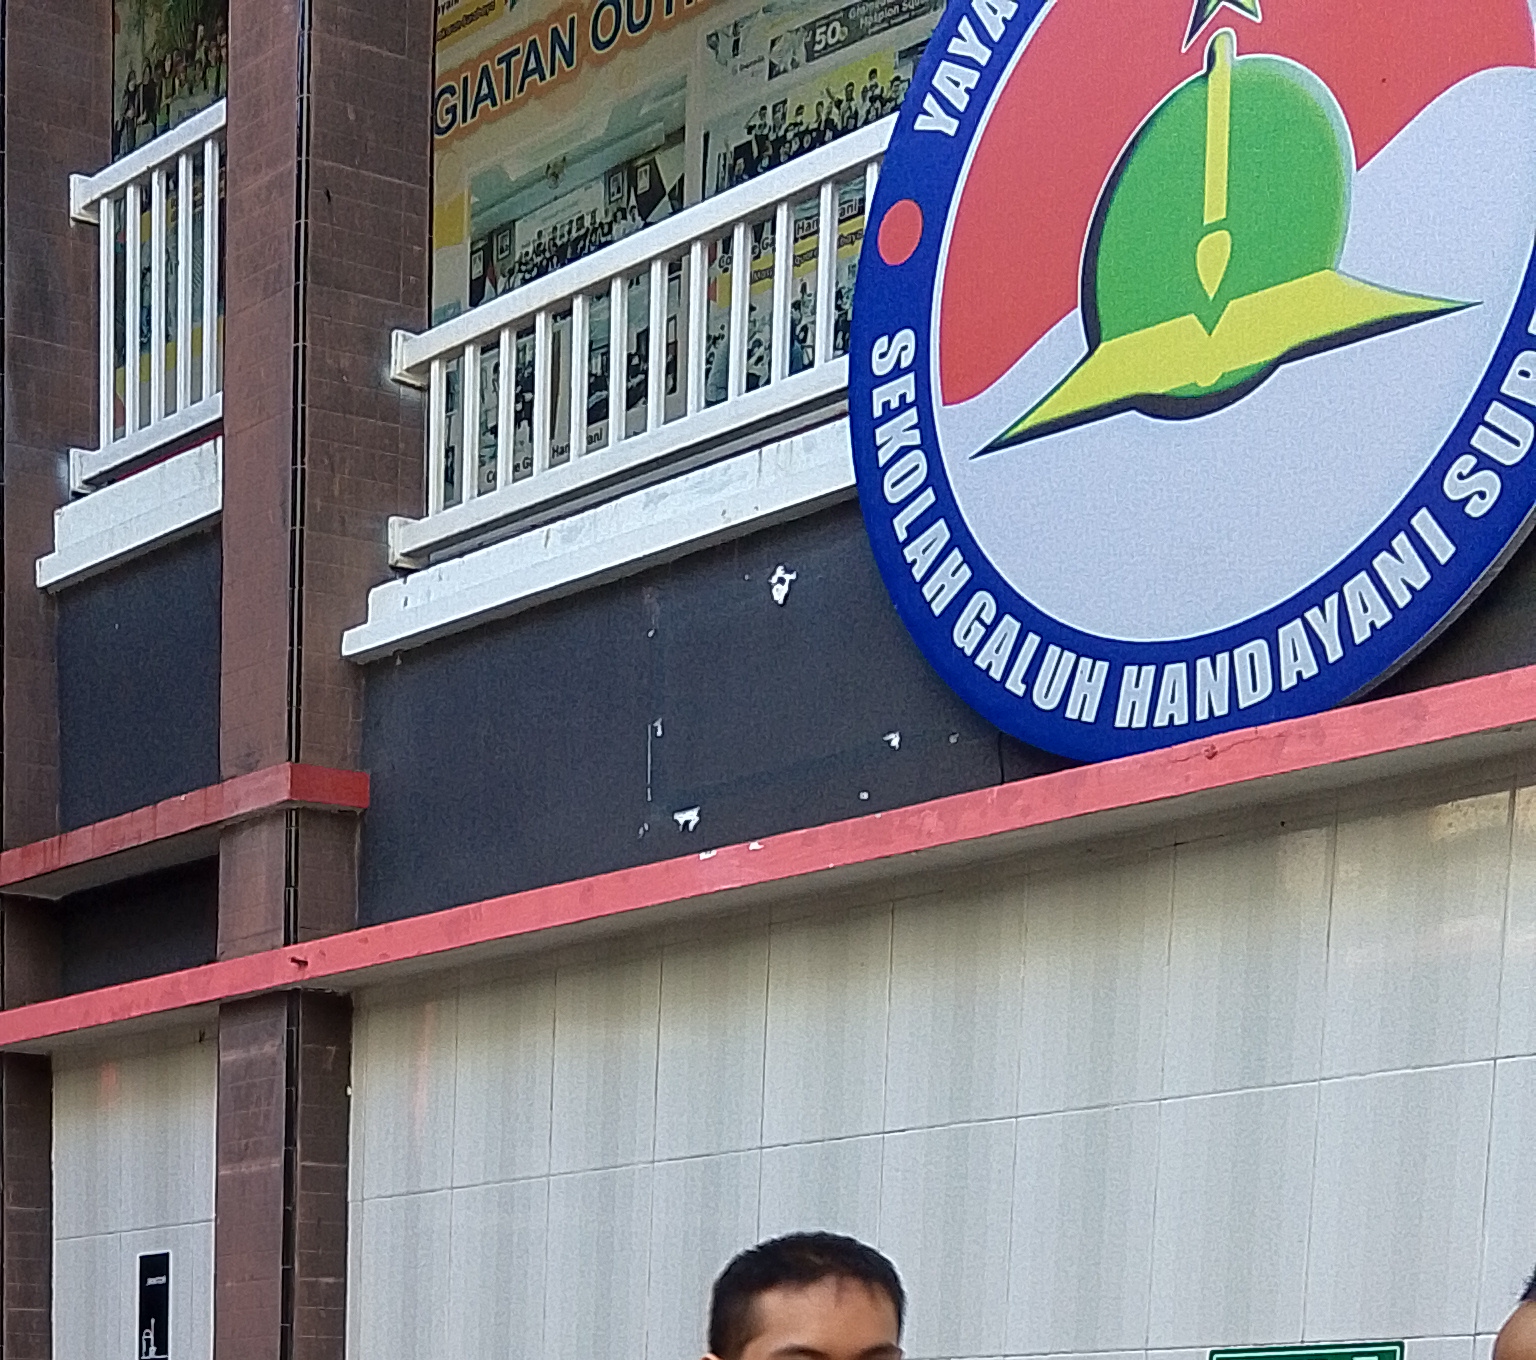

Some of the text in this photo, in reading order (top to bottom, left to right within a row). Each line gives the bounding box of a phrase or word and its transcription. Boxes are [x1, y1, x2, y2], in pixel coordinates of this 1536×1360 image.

[434, 14, 577, 137] GIATAN
[871, 328, 973, 618] SEKOLAH
[952, 590, 1109, 724] GALUH
[1114, 505, 1457, 729] HANDAYANI
